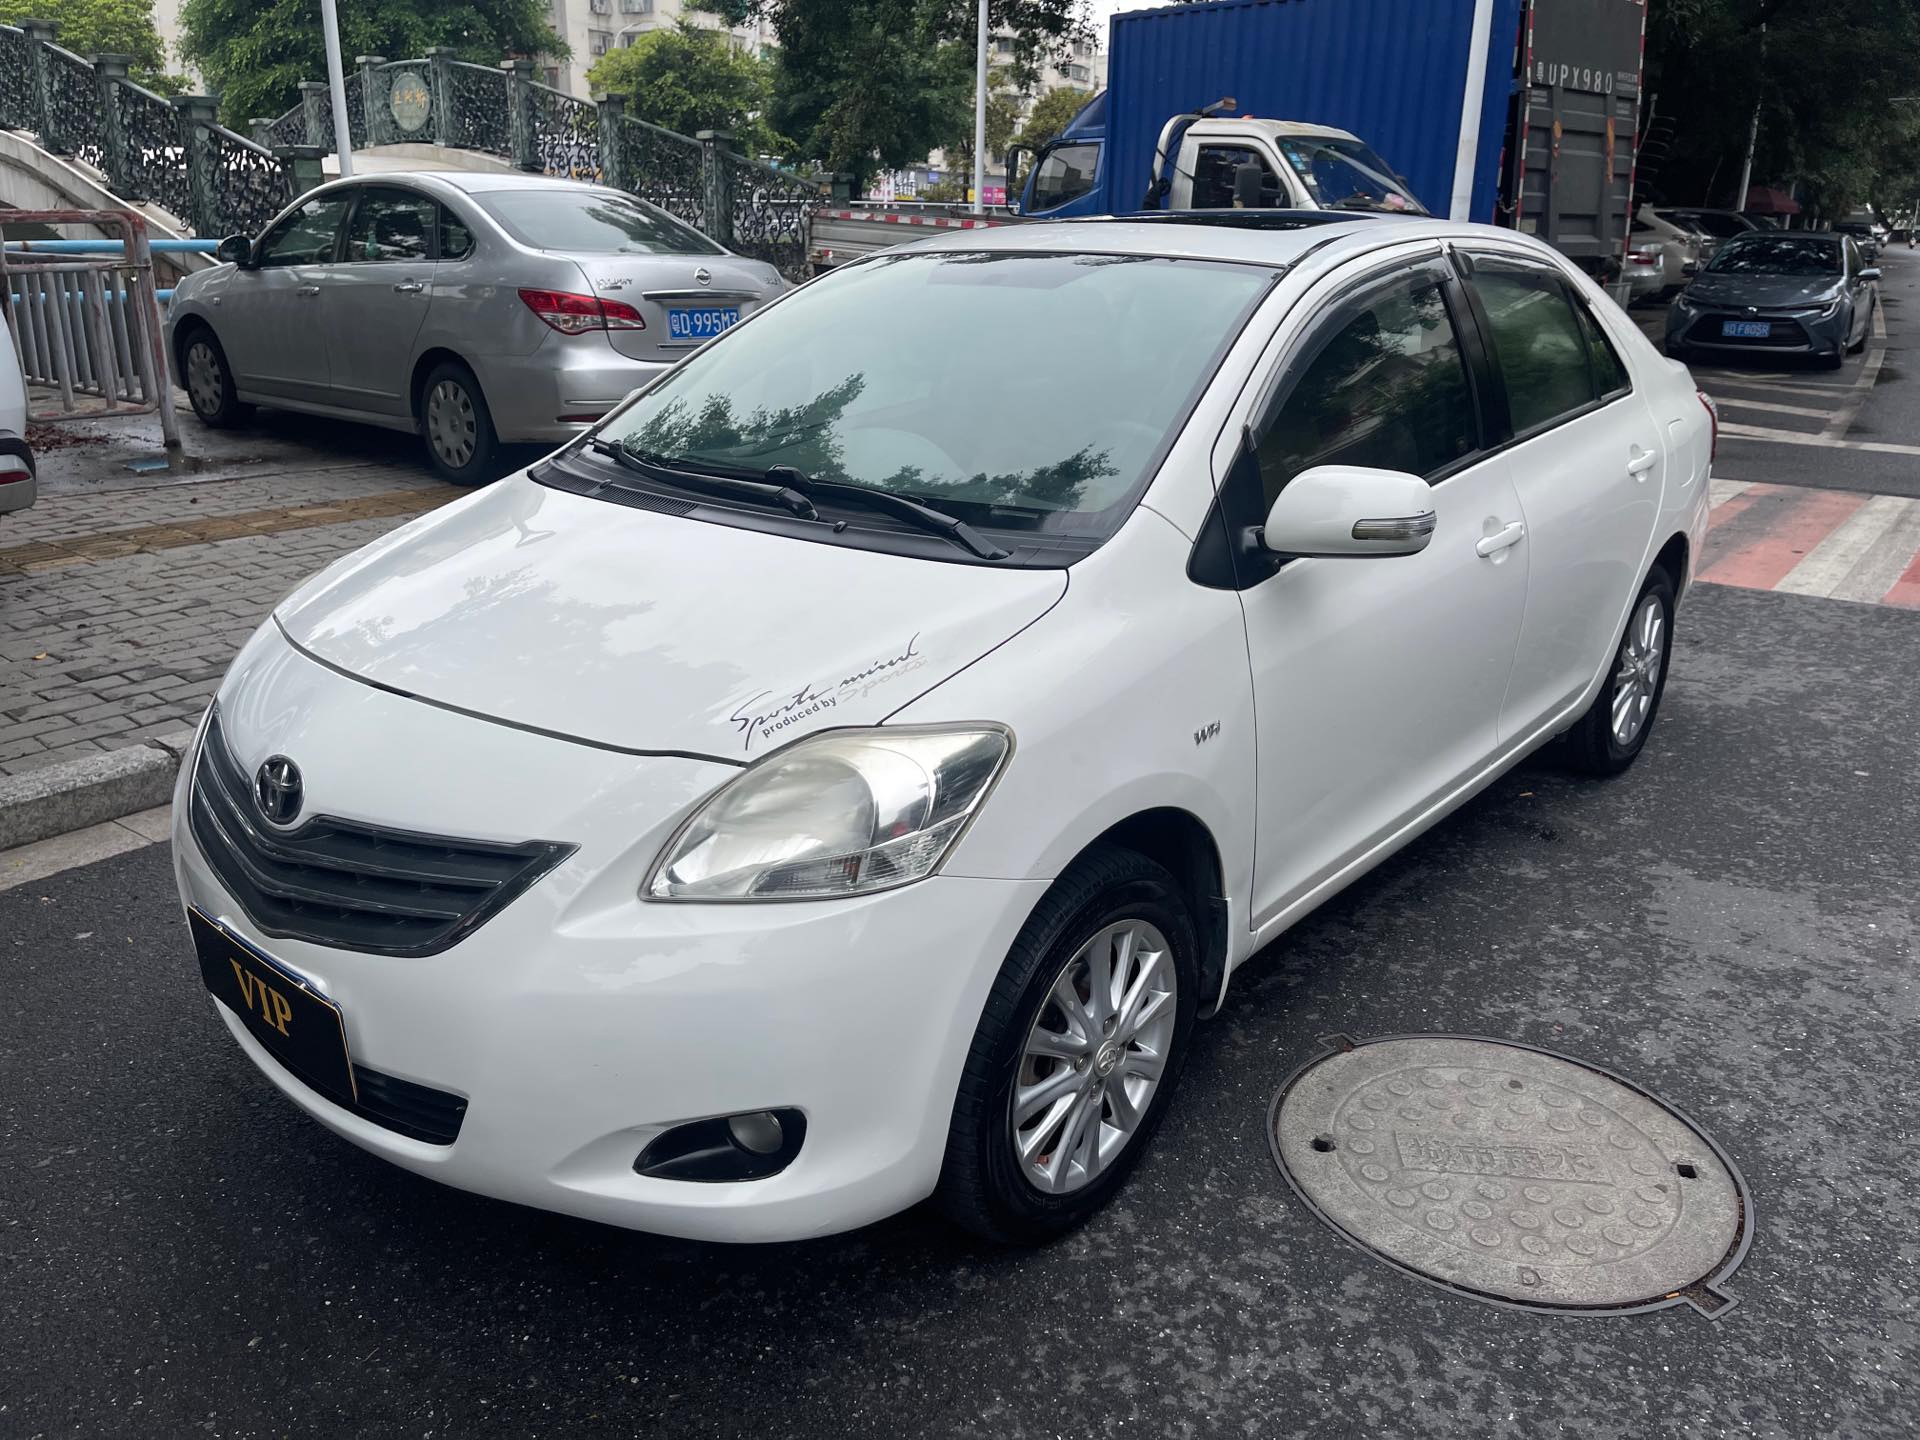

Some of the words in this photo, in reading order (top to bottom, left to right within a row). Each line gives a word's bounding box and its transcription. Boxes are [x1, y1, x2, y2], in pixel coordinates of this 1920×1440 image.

[839, 632, 920, 687] mind
[762, 703, 820, 738] produced
[821, 696, 837, 707] by
[229, 957, 292, 1037] VIP
